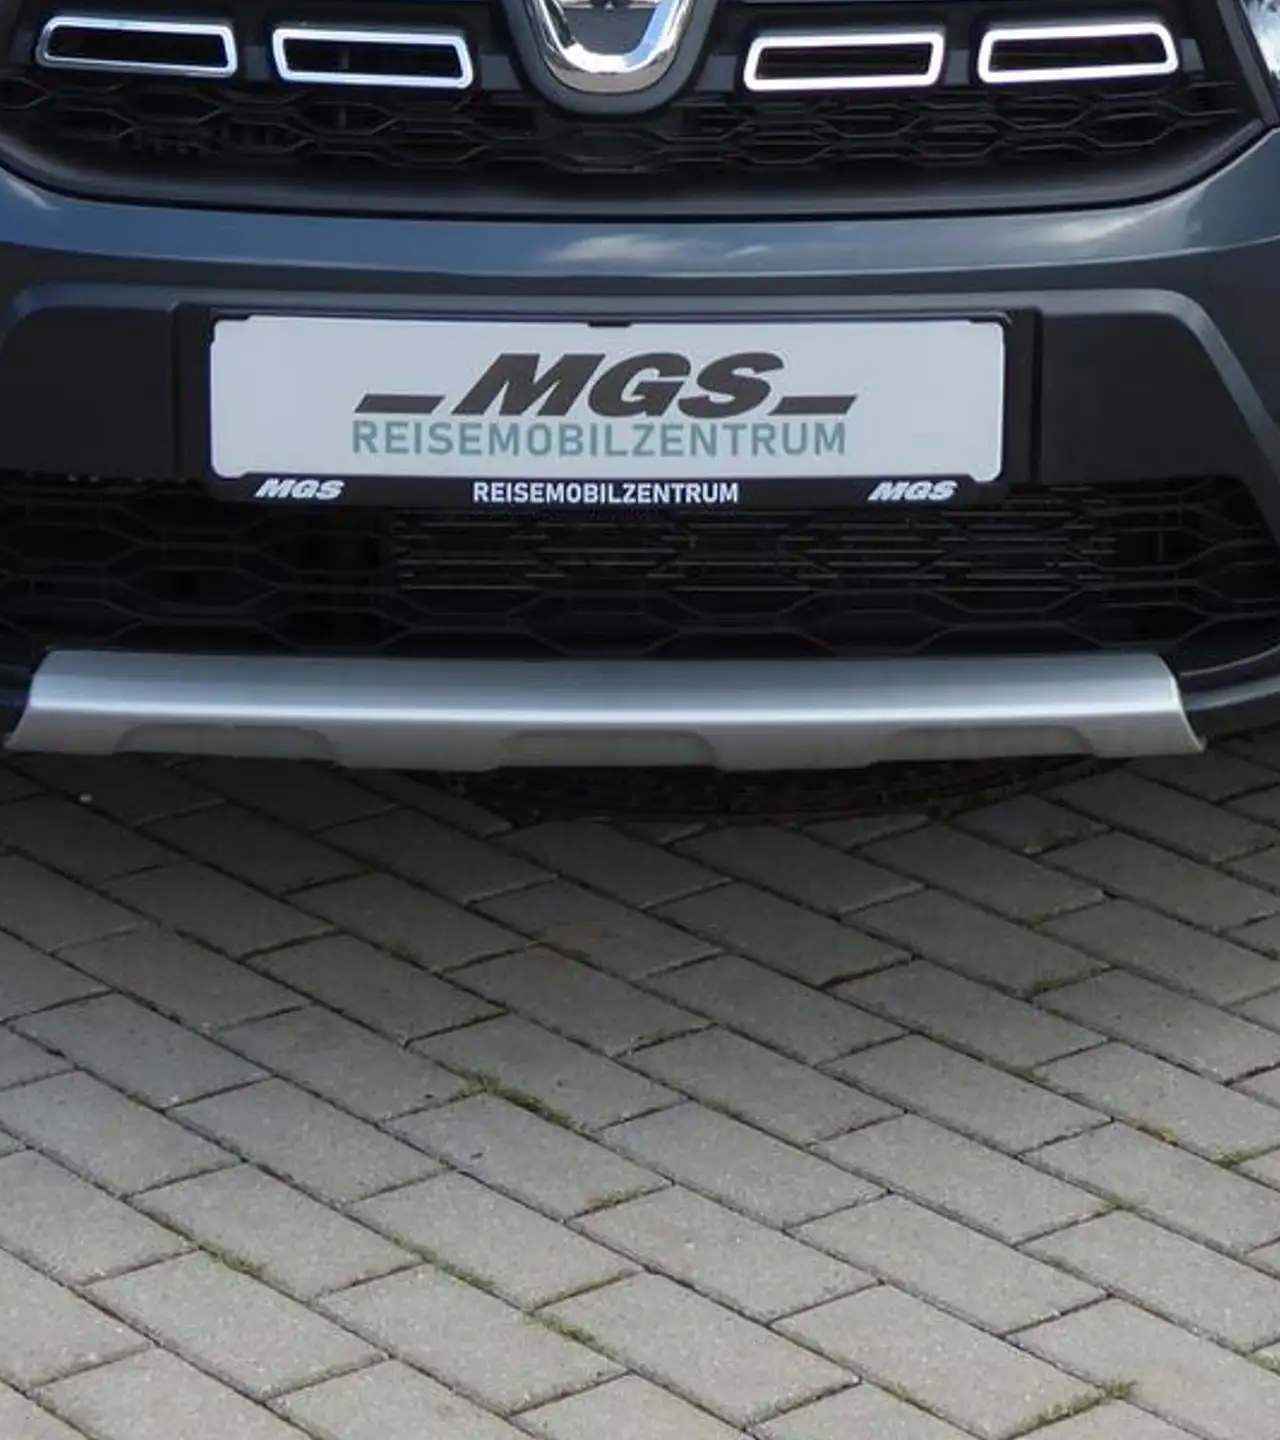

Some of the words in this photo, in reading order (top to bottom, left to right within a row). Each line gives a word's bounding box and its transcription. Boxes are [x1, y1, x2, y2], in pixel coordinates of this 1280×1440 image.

[450, 351, 785, 419] MGS
[351, 419, 847, 457] REISEMOBILZENTRUM
[253, 478, 345, 501] MGS
[473, 480, 739, 504] REISEMOBILZENTRUM
[867, 479, 959, 502] MGS
